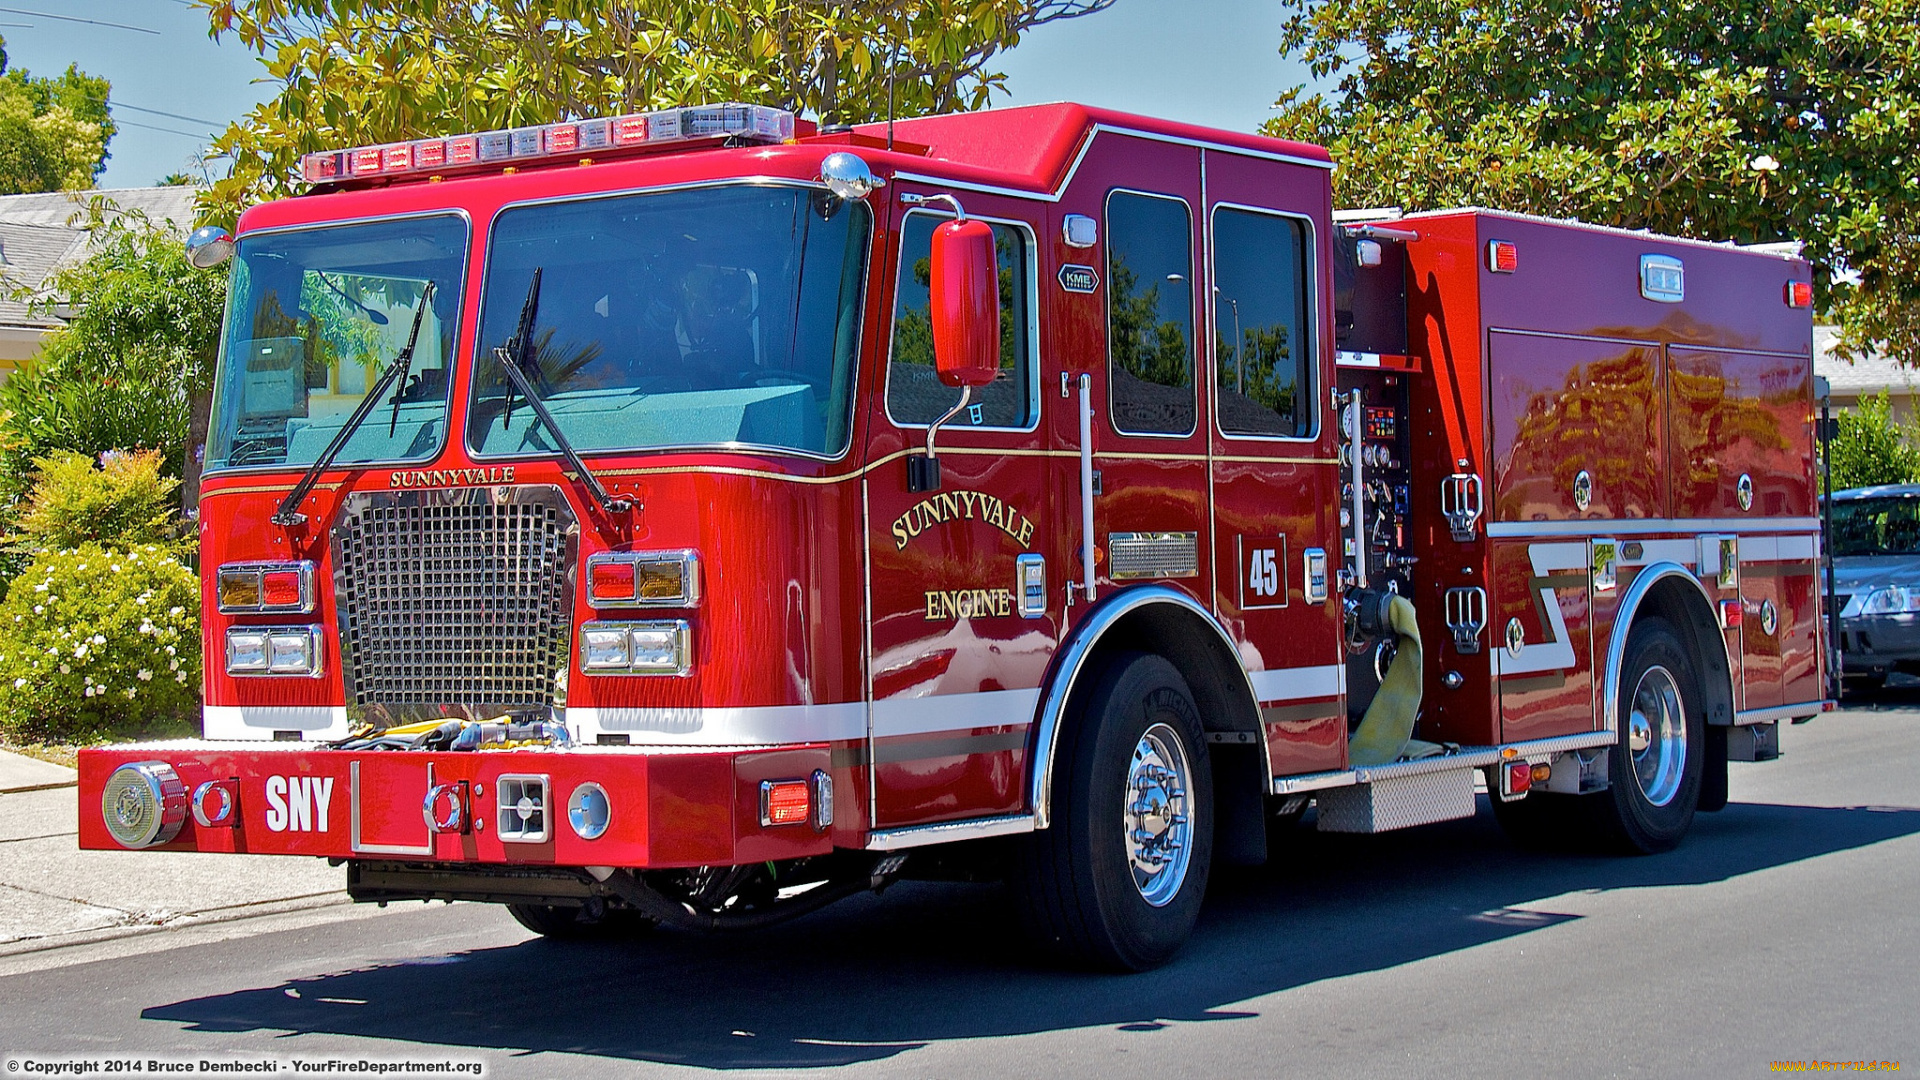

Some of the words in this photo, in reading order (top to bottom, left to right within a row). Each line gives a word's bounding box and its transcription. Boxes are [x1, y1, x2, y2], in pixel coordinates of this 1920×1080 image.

[1066, 272, 1091, 285] KME
[390, 466, 515, 487] SUNNYVALE
[892, 491, 1034, 550] SUNNYVALE
[1250, 549, 1278, 596] 45
[924, 588, 1011, 620] ENGINE
[266, 775, 334, 832] SNY
